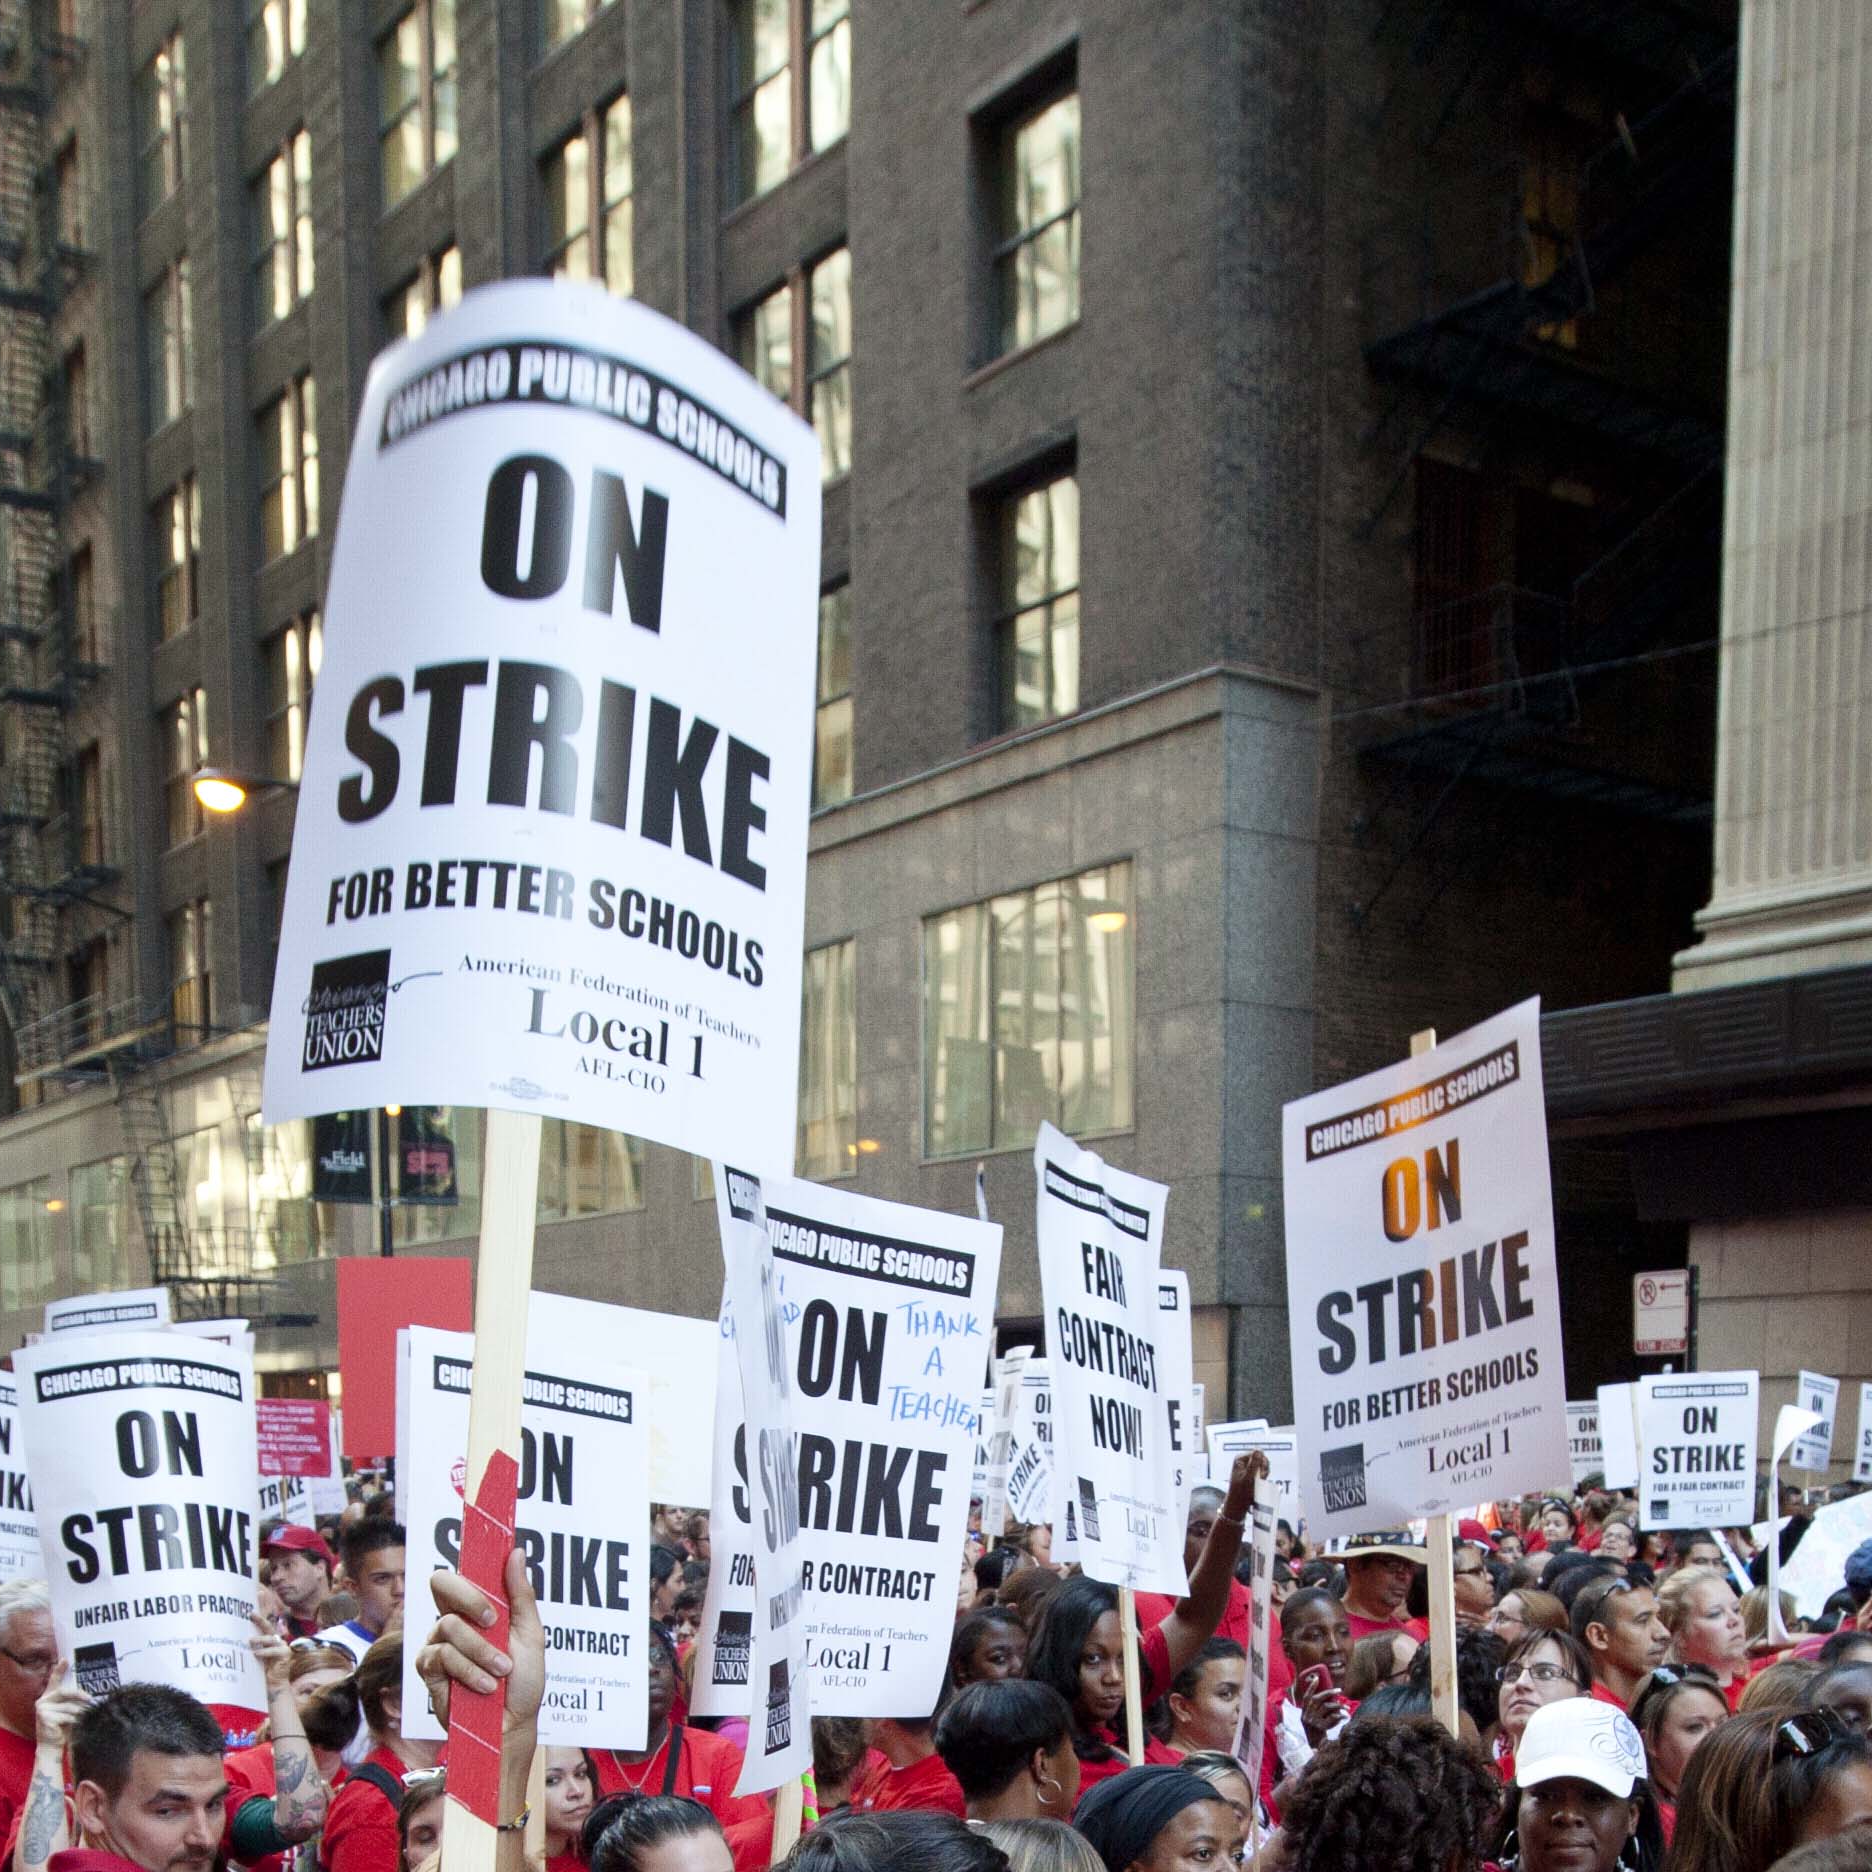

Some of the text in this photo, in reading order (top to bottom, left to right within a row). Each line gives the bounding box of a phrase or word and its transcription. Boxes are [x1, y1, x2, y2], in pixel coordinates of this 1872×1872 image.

[386, 345, 781, 510] CHICAGO PUBLIC SCHOOLS
[480, 453, 670, 634] ON
[337, 658, 771, 893] STRIKE
[327, 858, 766, 988] FOR BETTER SCHOOLS
[307, 1002, 384, 1037] TEACHERS
[458, 953, 762, 1049] American Federation of Teachers
[306, 1024, 383, 1066] UNION
[524, 985, 707, 1081] Local 1
[575, 1055, 666, 1096] AFL-CIO
[1310, 1051, 1516, 1155] CHICAGO PUBLIC SCHOOLS
[1381, 1136, 1462, 1244] ON
[818, 1231, 970, 1289] PUBLIC SCHOOLS
[1081, 1241, 1128, 1308] FAIR
[896, 1300, 983, 1340] THANK
[1316, 1229, 1534, 1376] STRIKE
[797, 1298, 888, 1407] ON
[922, 1346, 945, 1377] A
[1058, 1306, 1158, 1394] CONTRACT
[40, 1363, 240, 1397] CHICAGO PUBLIC SCHOOLS
[523, 1375, 630, 1418] UBLIC SCHOOLS
[1322, 1346, 1540, 1432] FOR BETTER SCHOOLS
[887, 1385, 979, 1438] TEACHER
[1089, 1393, 1145, 1462] NOW!
[1395, 1403, 1543, 1452] American Federation of Teachers
[1578, 1416, 1598, 1433] ON
[1682, 1405, 1718, 1435] ON
[115, 1409, 204, 1479] ON
[1427, 1427, 1511, 1473] Local 1
[1652, 1443, 1746, 1474] STRIKE
[1008, 1442, 1042, 1505] STRIKE
[1323, 1473, 1366, 1495] TEACHERS
[1449, 1465, 1494, 1486] AFL-CIO
[1653, 1479, 1746, 1493] FOR FAIR CONTRACT
[1324, 1486, 1367, 1511] UNION
[60, 1502, 253, 1584] STRIKE
[818, 1561, 936, 1602] CONTRACT
[74, 1594, 194, 1629] UNFAIR LABOR
[820, 1622, 929, 1643] Federation of Teachers
[181, 1647, 236, 1671] Local
[543, 1624, 631, 1658] CONTRACT
[806, 1638, 893, 1672] Local 1
[713, 1661, 749, 1682] UNION
[820, 1674, 867, 1688] AFL-CIO
[550, 1712, 589, 1725] AFL-CIO
[595, 1689, 605, 1712] 1
